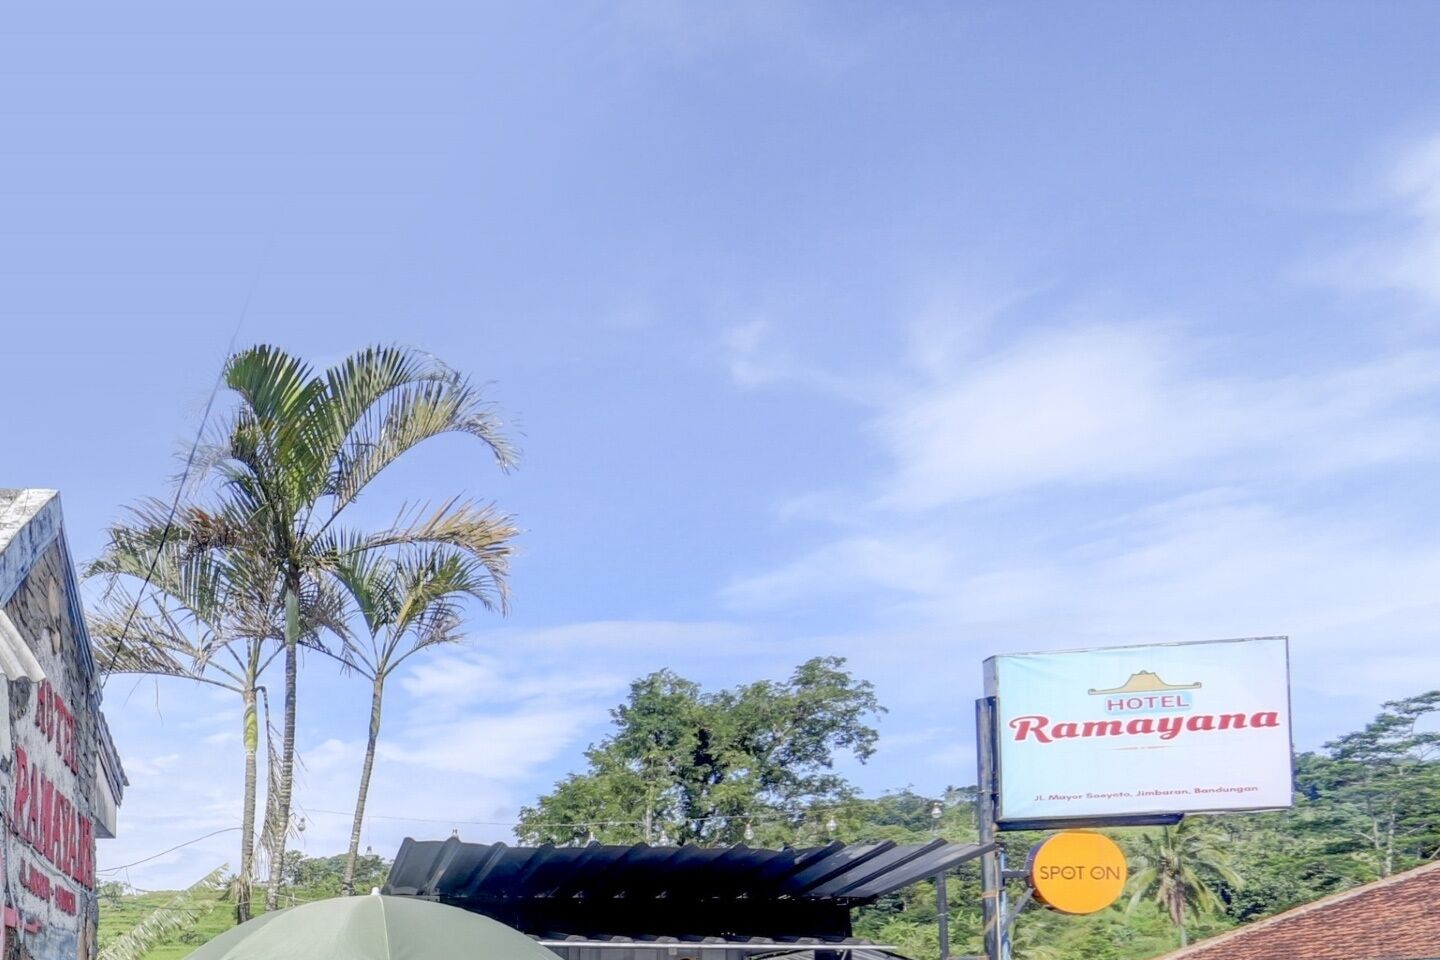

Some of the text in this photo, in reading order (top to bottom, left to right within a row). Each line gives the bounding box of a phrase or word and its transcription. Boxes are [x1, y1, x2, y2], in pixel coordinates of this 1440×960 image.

[1107, 694, 1189, 711] HOTEL
[1009, 711, 1280, 743] Ramayana
[1048, 794, 1082, 802] Mayor
[1193, 785, 1259, 794] Bandungan
[1040, 865, 1121, 880] SPOT ON
